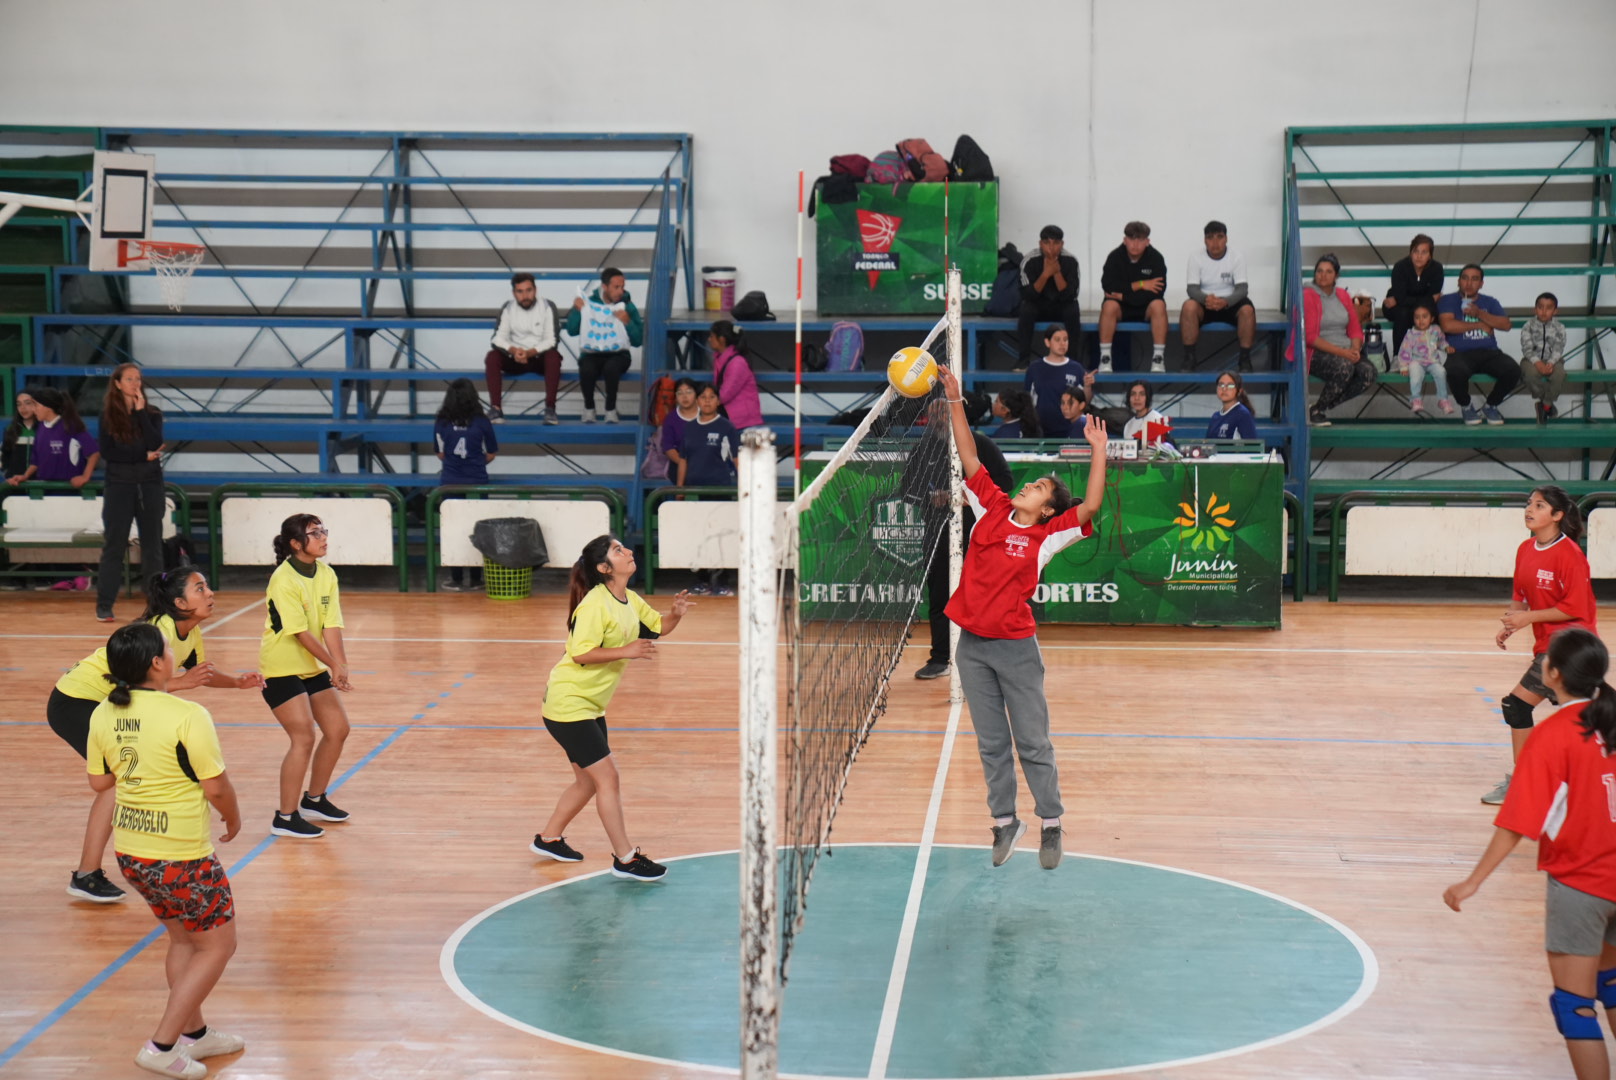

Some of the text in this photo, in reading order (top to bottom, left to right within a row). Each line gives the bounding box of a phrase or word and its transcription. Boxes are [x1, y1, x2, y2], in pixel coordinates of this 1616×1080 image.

[855, 261, 897, 270] FEDERAL
[453, 437, 467, 459] 4
[114, 718, 140, 732] JUNIN
[120, 746, 141, 786] 2
[118, 805, 168, 834] BERGOGLIO
